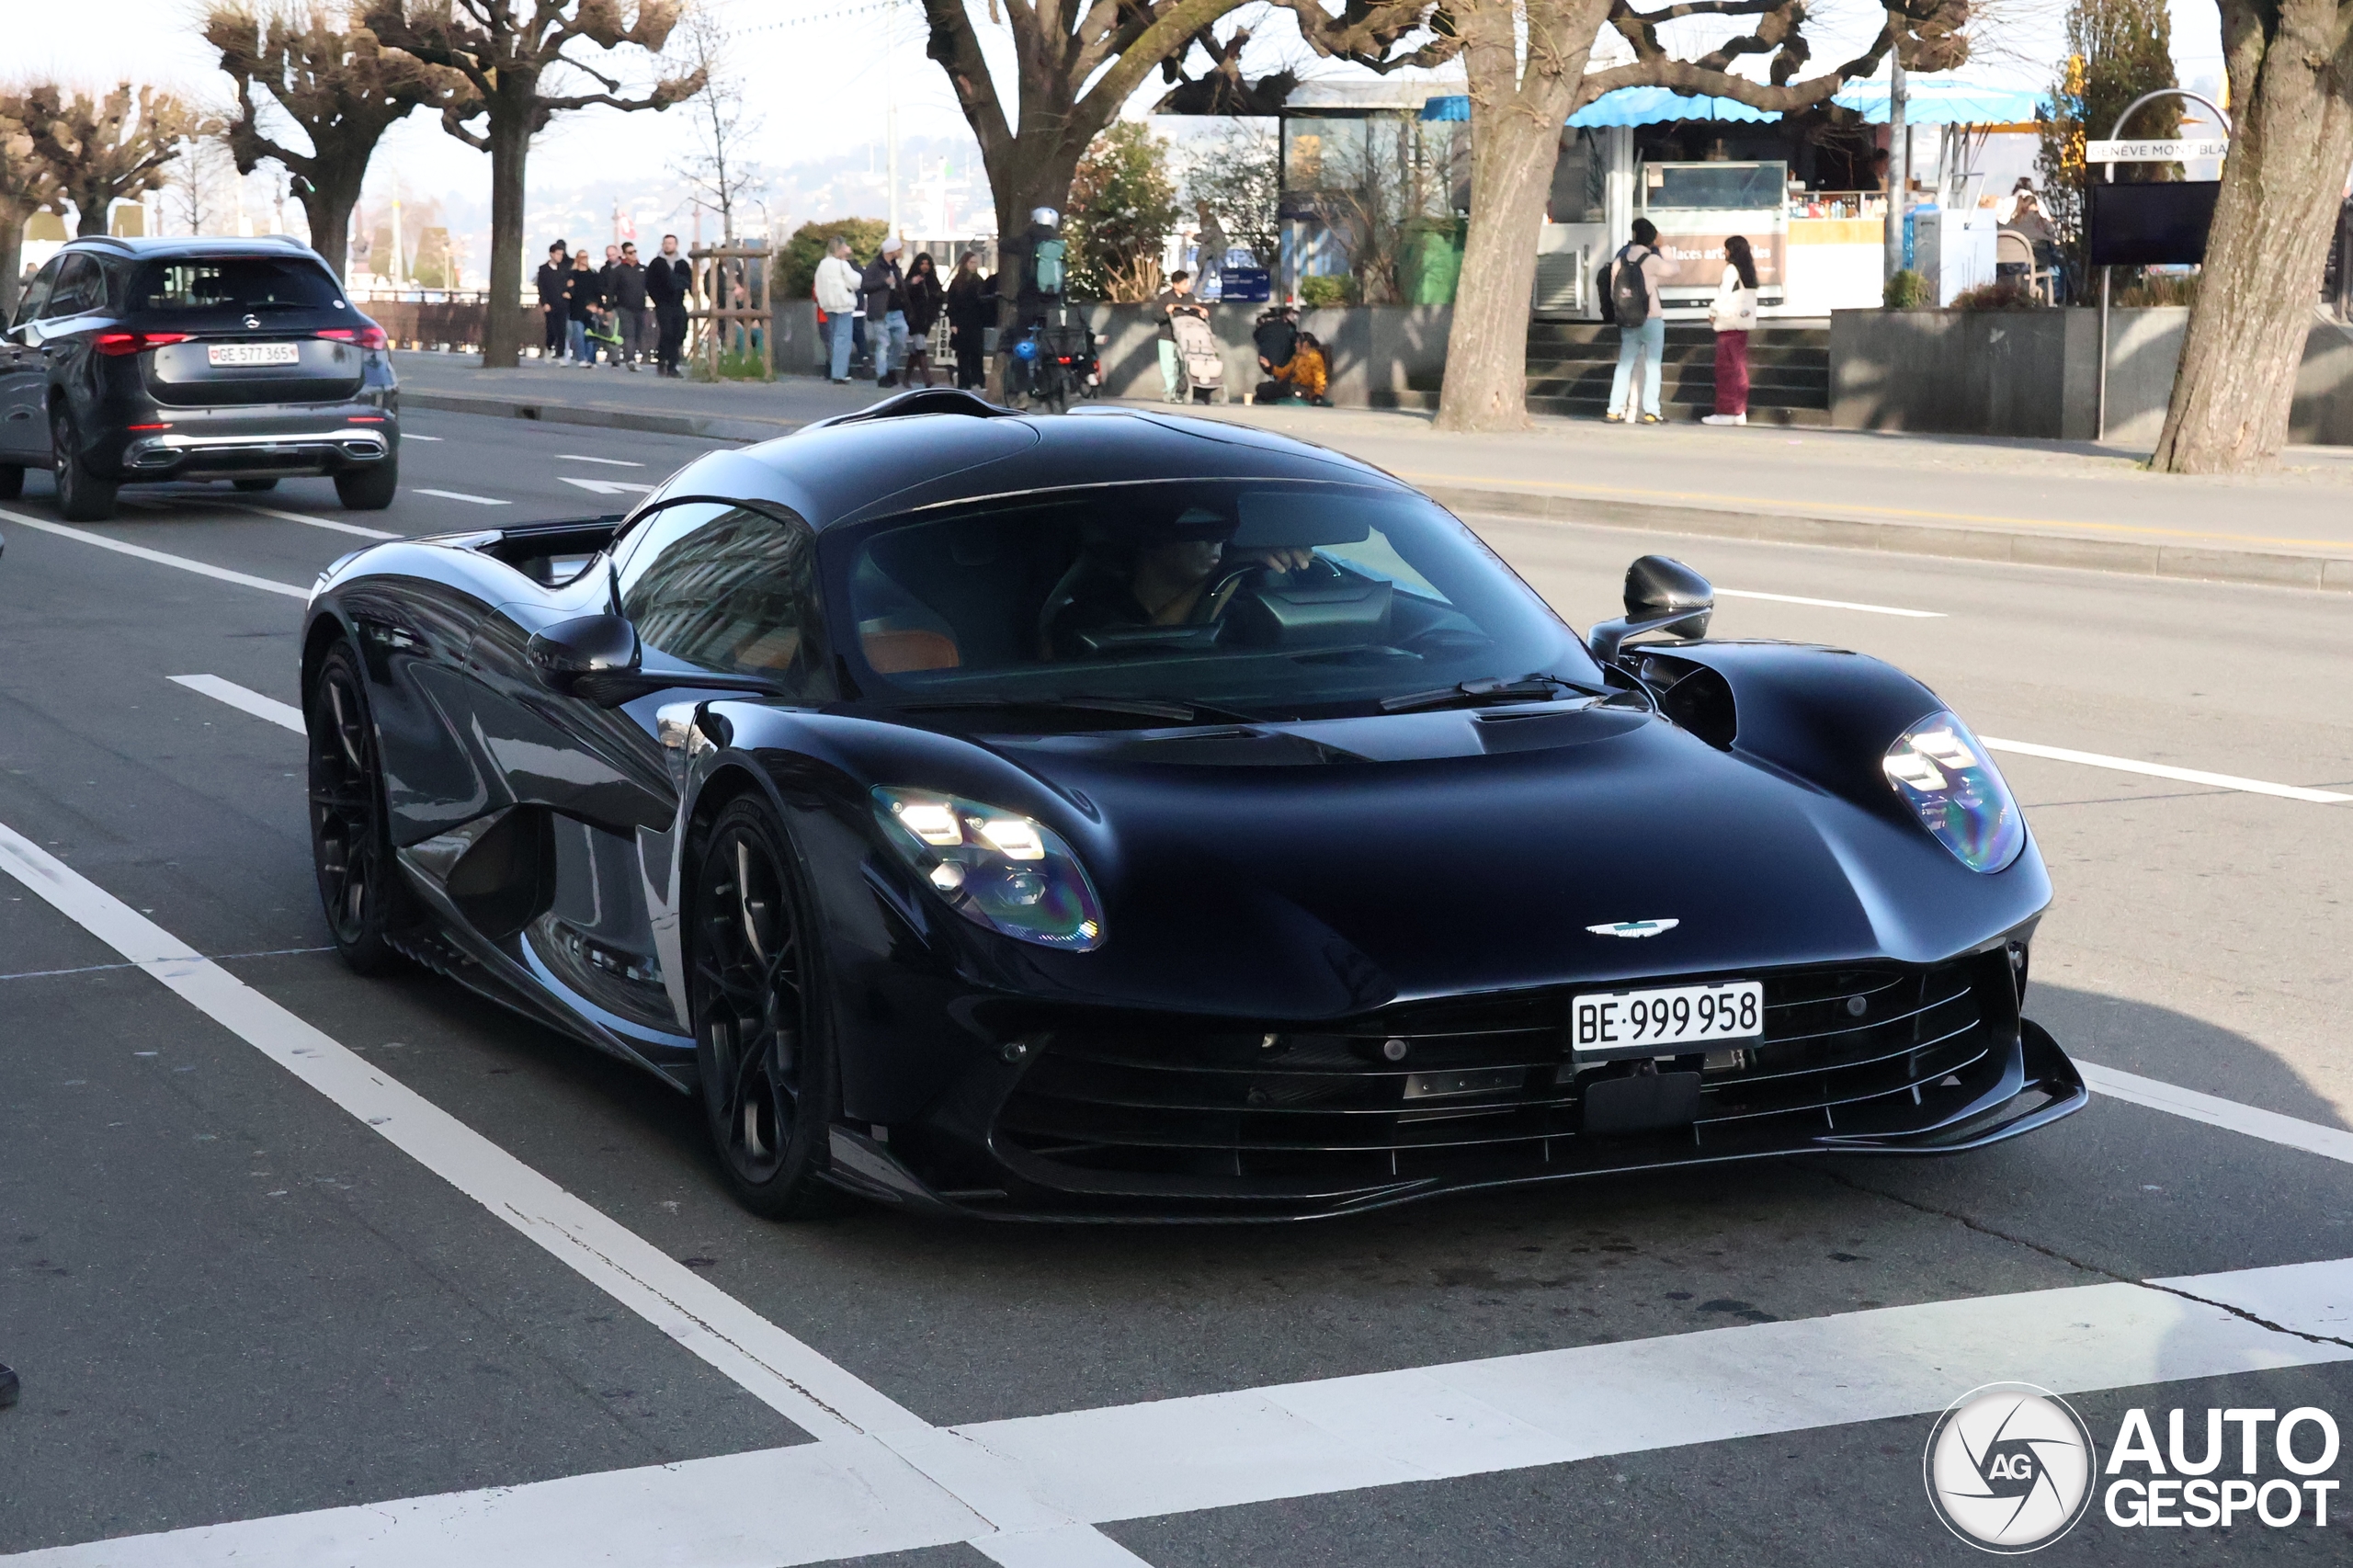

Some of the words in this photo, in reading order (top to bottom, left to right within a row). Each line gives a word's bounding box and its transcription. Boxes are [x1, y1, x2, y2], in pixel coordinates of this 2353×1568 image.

[2153, 143, 2228, 155] MONT-BLA
[1671, 245, 1702, 260] laces
[239, 347, 262, 360] 577
[267, 347, 289, 360] 365
[1698, 992, 1757, 1034] 958
